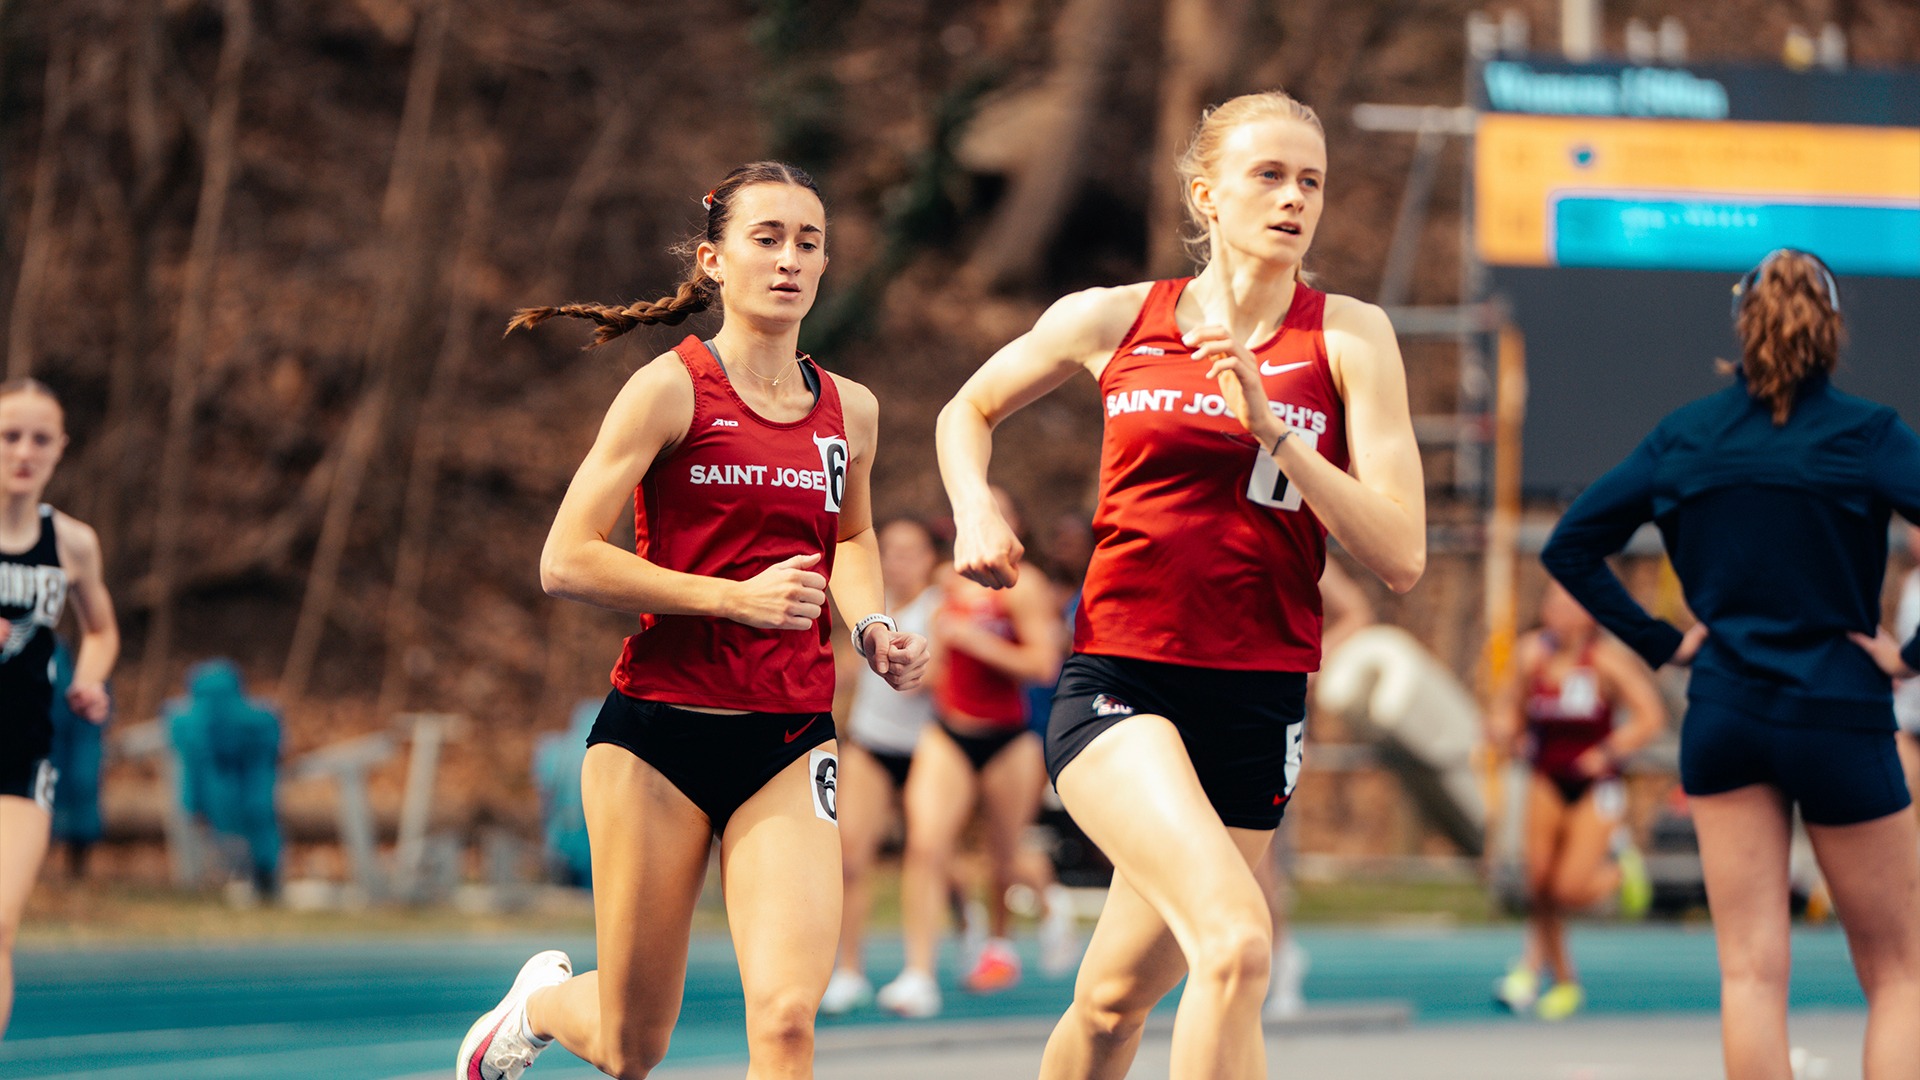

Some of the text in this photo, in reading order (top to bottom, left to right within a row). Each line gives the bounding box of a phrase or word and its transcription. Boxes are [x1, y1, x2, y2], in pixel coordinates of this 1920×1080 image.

[1106, 389, 1328, 435] SAINT JOPH'S
[689, 464, 827, 492] SAINT JOSE
[826, 443, 845, 509] 6
[1098, 703, 1133, 716] SJU
[815, 757, 837, 821] 6
